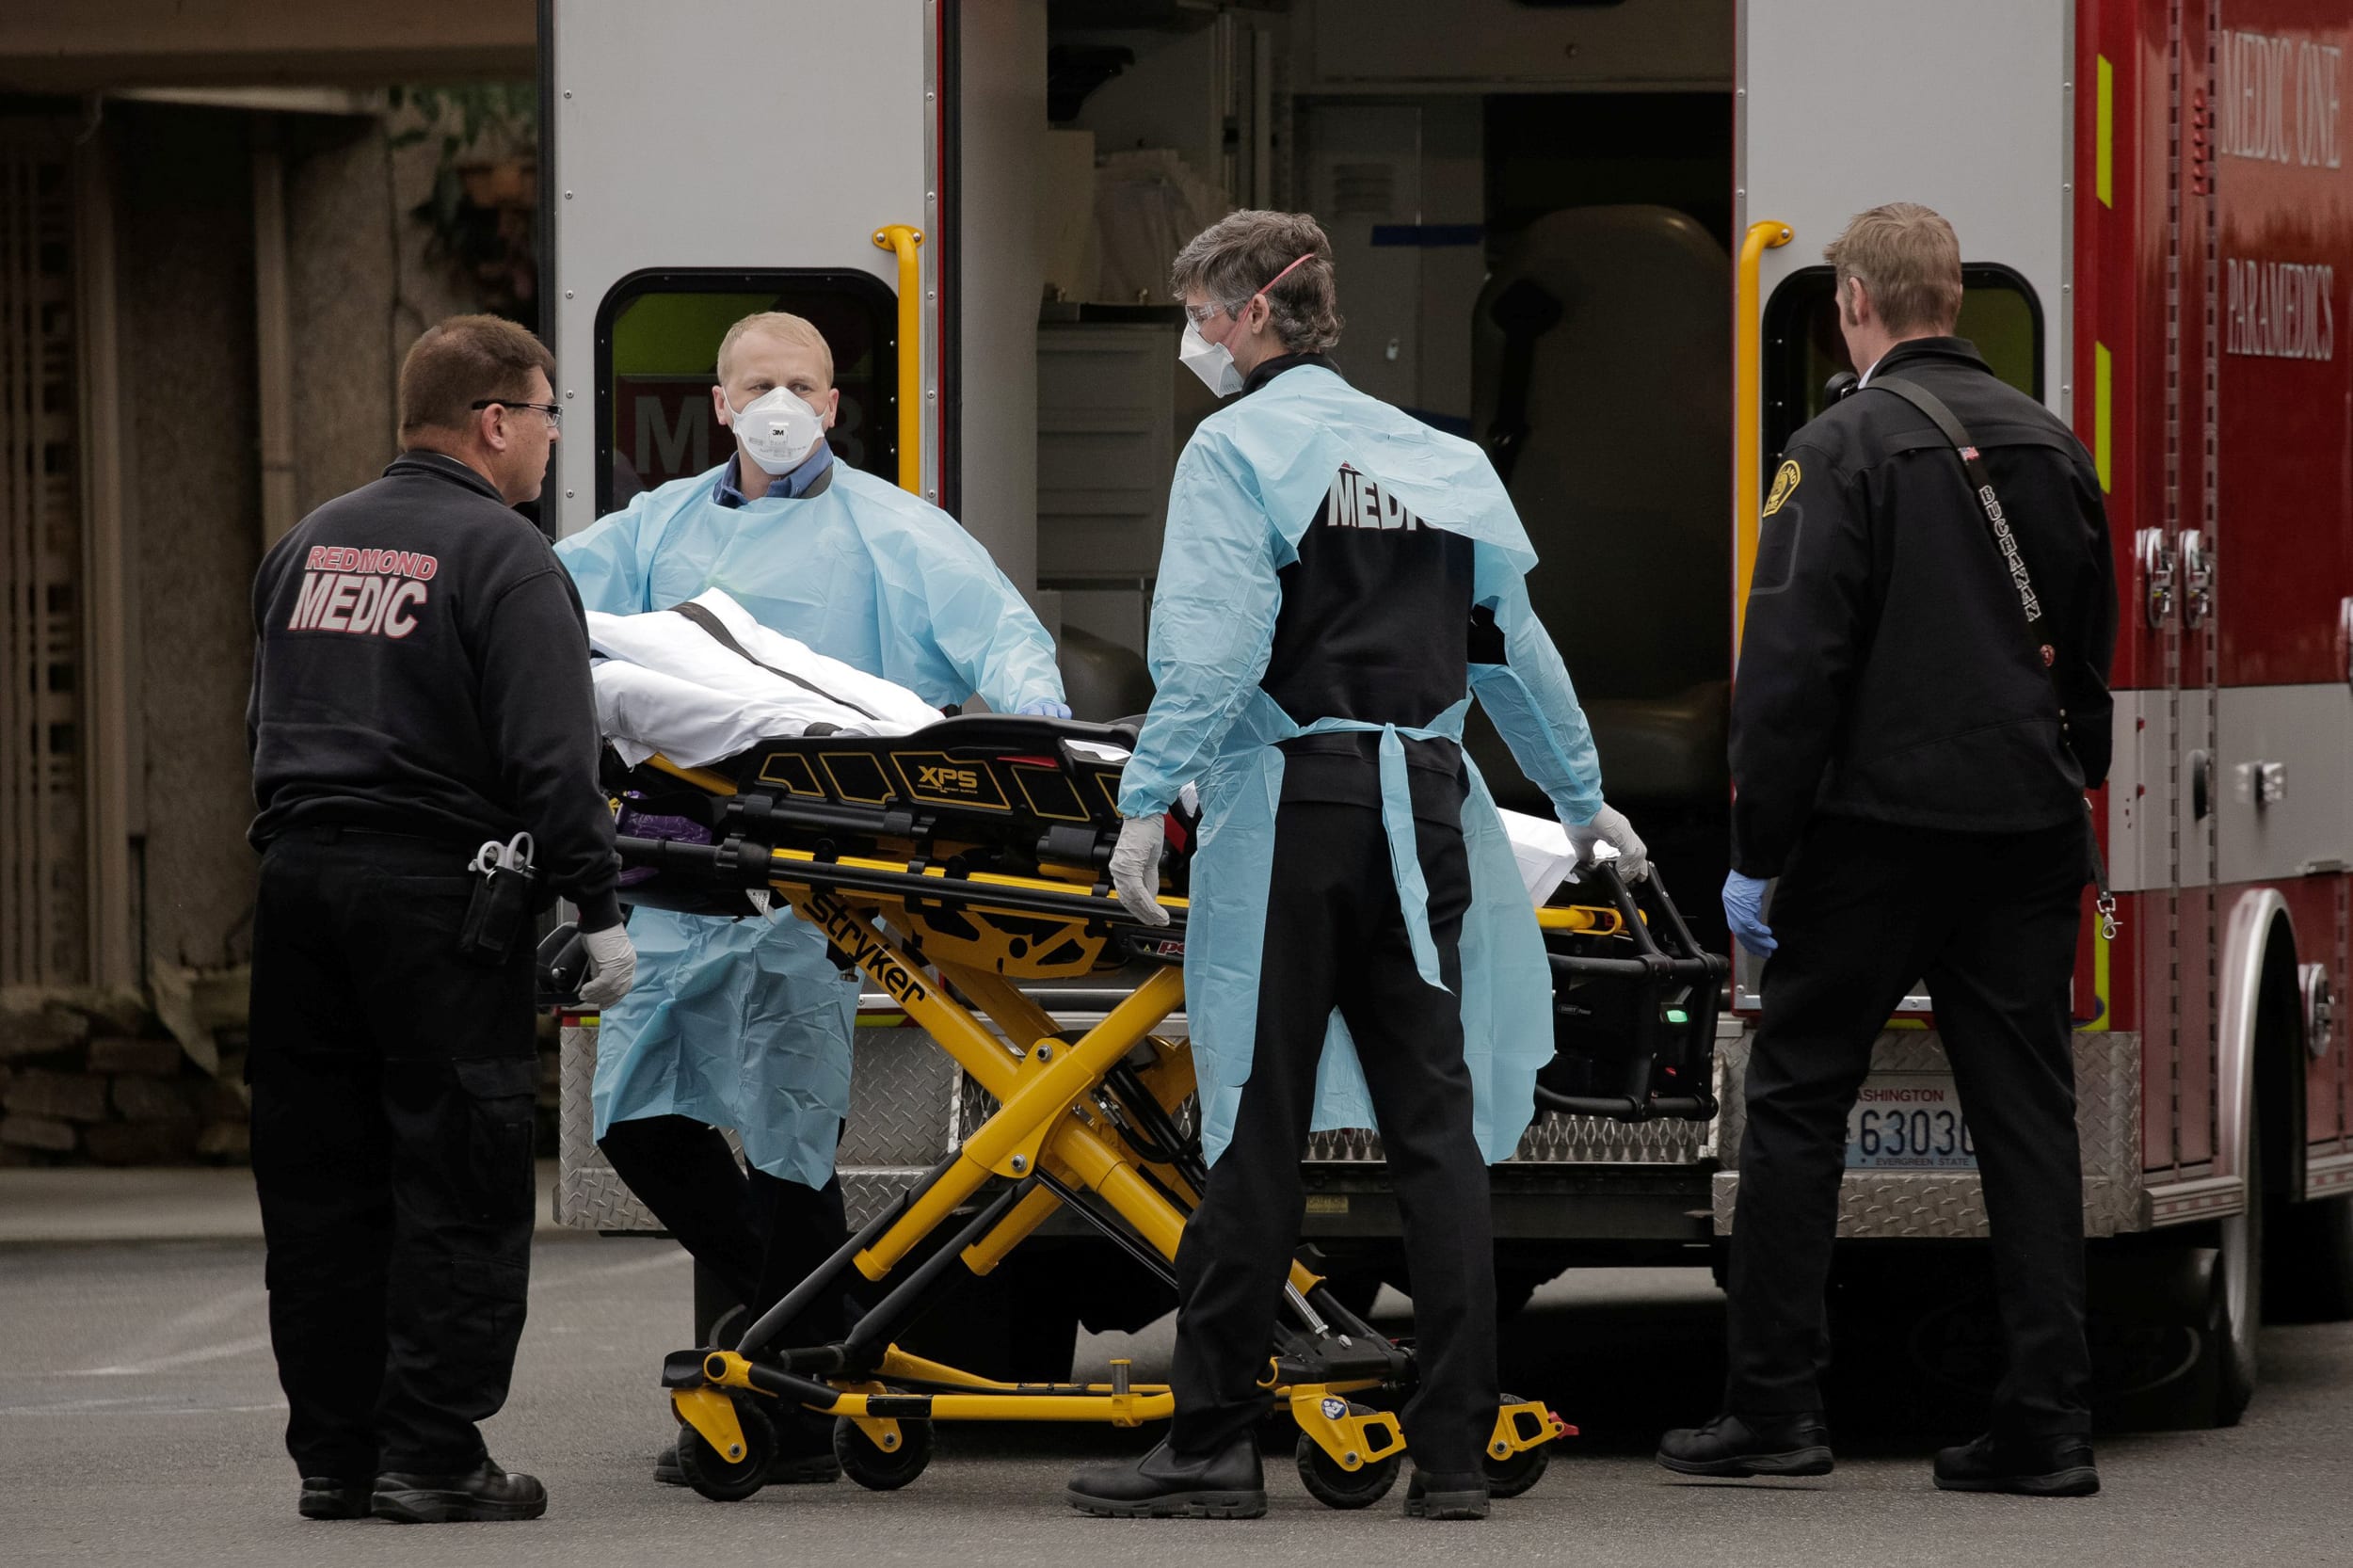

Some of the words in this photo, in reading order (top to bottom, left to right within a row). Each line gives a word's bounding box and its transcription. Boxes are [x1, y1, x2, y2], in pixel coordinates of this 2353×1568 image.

[2221, 29, 2292, 165] MEDIC
[2297, 40, 2342, 169] ONE
[2227, 258, 2333, 361] PARAMEDICS
[305, 546, 438, 581] REDMOND
[1978, 485, 2041, 623] BUCHANAN
[287, 572, 427, 639] MEDIC
[919, 765, 978, 789] XPS
[802, 894, 925, 1003] stryker
[1875, 1158, 1933, 1166] EVERGREEN
[1938, 1158, 1970, 1166] STATE
